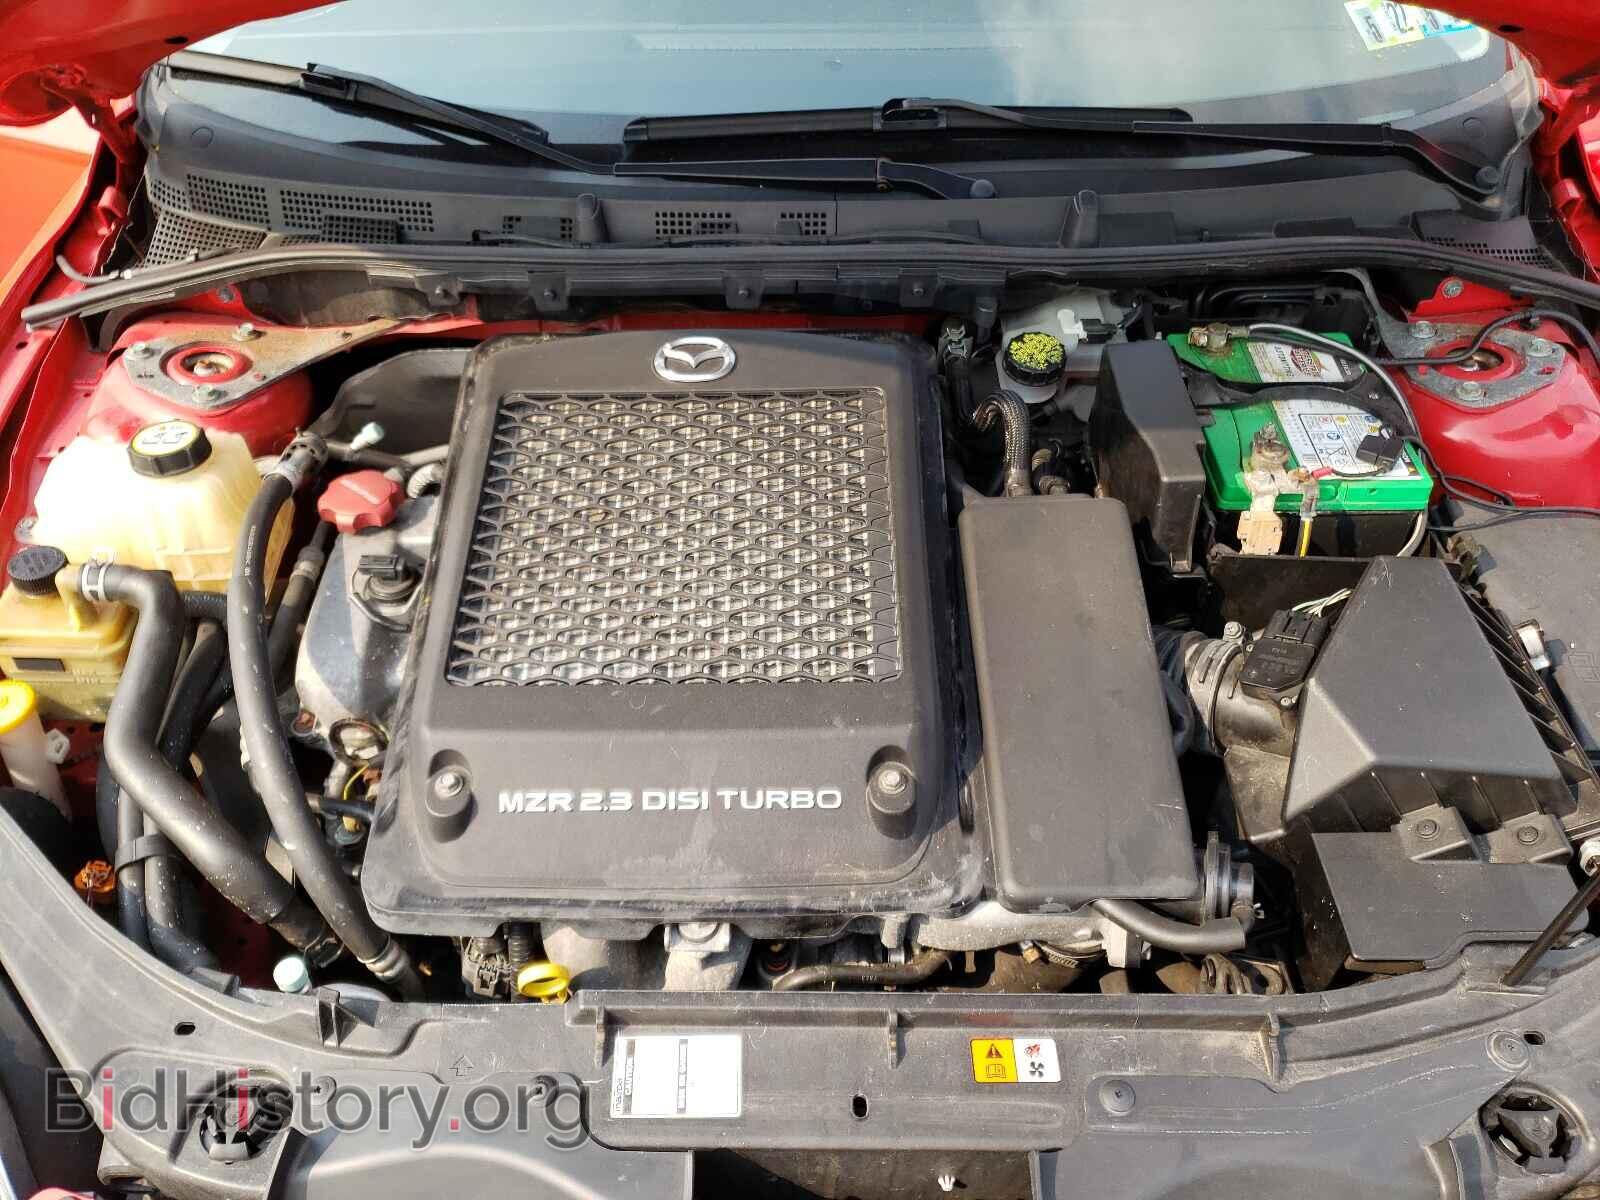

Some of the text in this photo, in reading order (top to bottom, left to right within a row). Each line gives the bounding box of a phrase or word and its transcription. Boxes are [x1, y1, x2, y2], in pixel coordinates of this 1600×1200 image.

[499, 789, 842, 812] MZR 2.3 DISI TURBO
